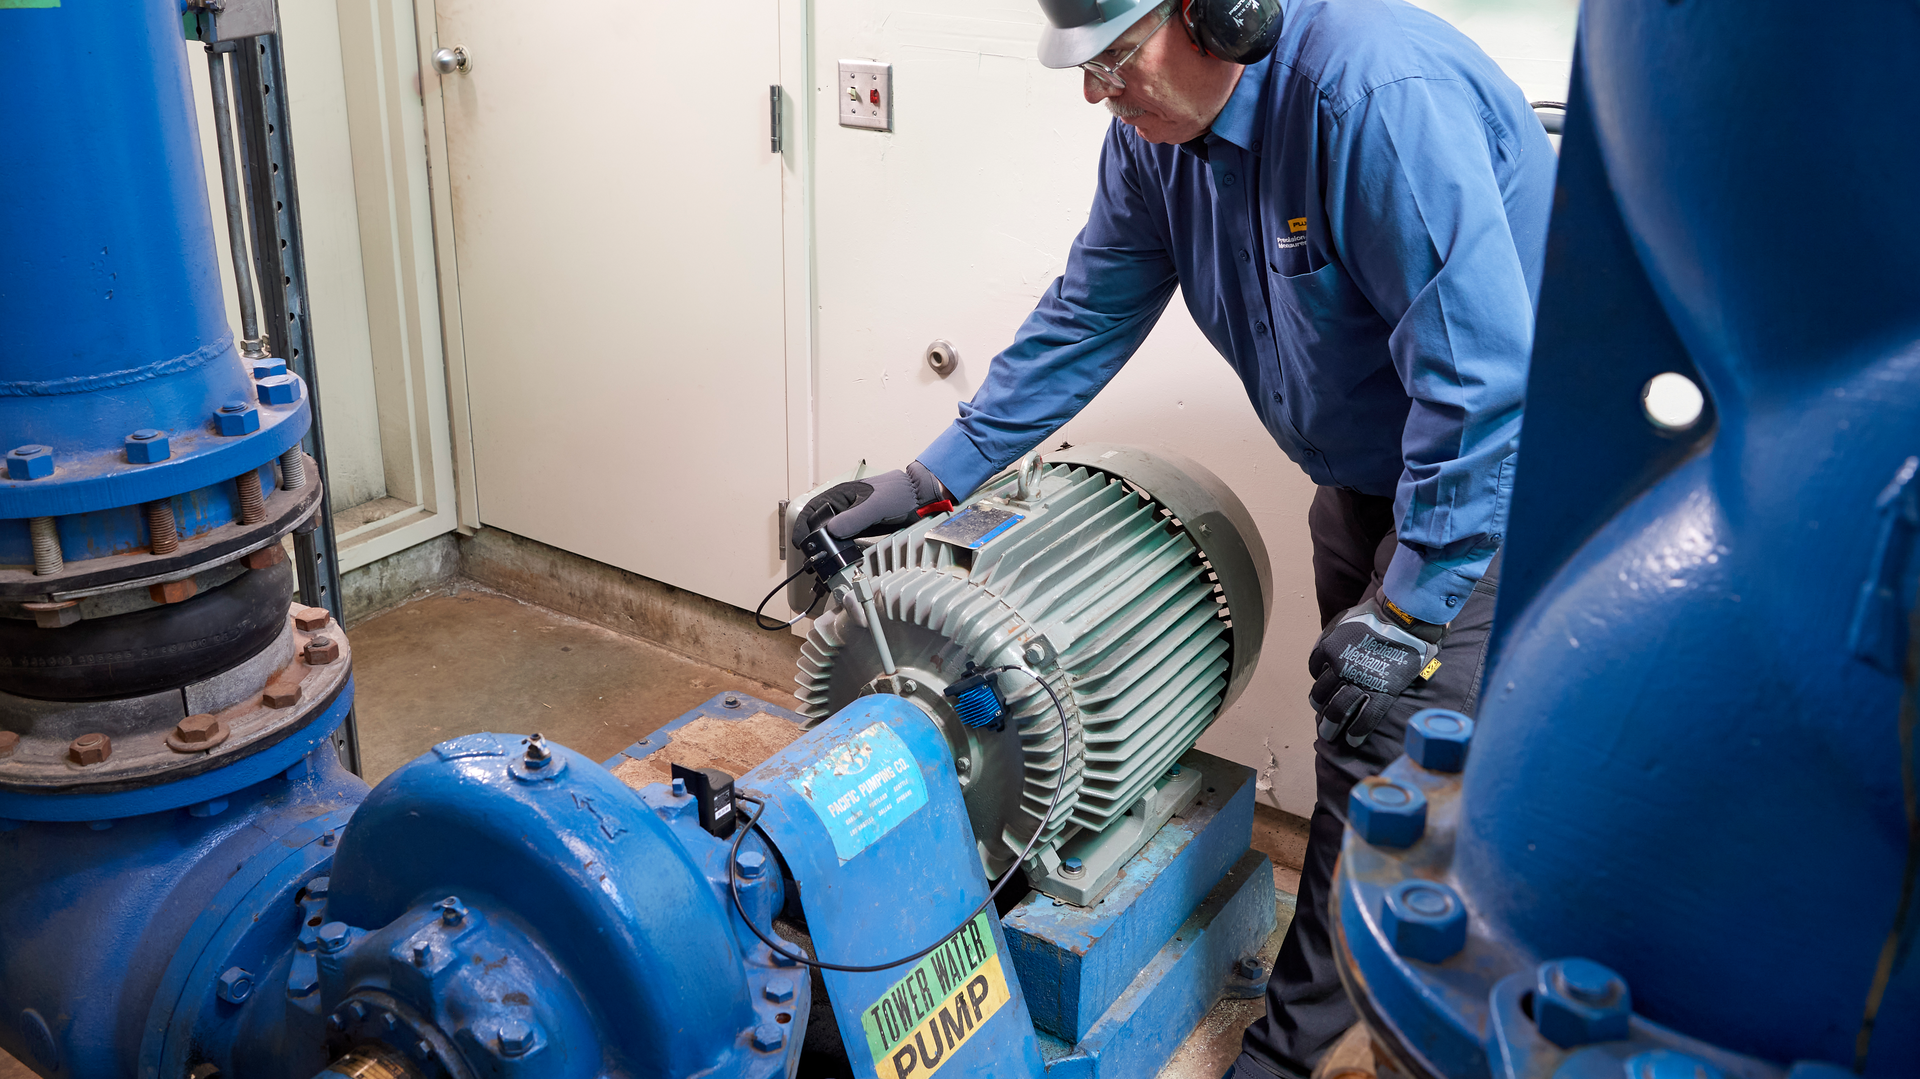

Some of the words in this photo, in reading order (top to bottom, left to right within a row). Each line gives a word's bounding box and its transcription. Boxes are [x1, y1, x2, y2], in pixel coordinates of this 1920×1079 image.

[827, 789, 860, 818] PACIFIC
[858, 766, 896, 797] PUMPING
[893, 757, 910, 774] CO.
[868, 793, 888, 809] PORTLAND
[893, 778, 909, 792] SEATTLE
[878, 803, 892, 817] DALLAS
[896, 789, 912, 804] SPOKANE
[870, 967, 935, 1051] TOWER
[930, 919, 987, 996] WATER
[892, 974, 989, 1079] PUMP
